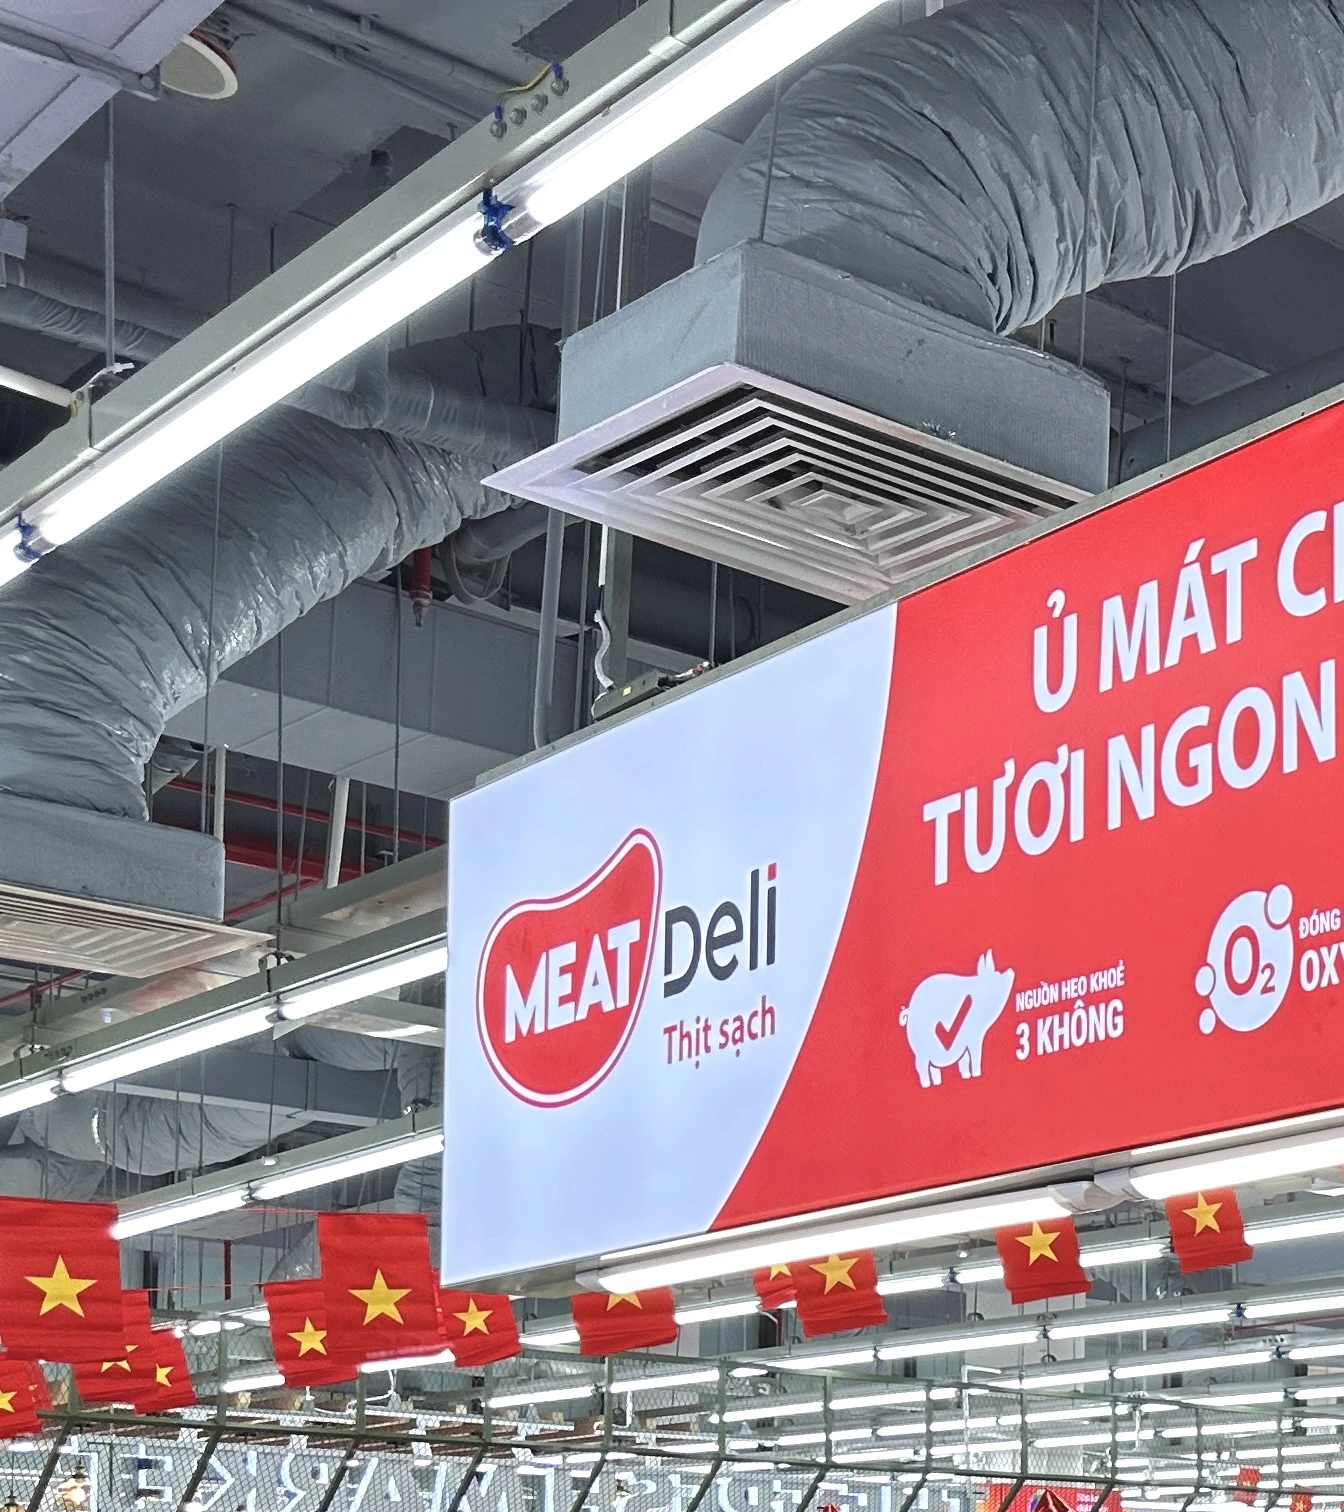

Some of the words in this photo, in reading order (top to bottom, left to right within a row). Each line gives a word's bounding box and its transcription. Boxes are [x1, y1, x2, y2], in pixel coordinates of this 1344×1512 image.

[1033, 589, 1078, 713] Ủ
[1099, 538, 1259, 693] MÁT
[922, 744, 1084, 886] TƯƠI
[1105, 660, 1336, 829] NGON
[663, 862, 778, 998] Deli
[1298, 906, 1339, 941] ĐÓNG
[503, 919, 642, 1044] MEAT
[1016, 980, 1059, 1014] NGUỒN
[1061, 975, 1087, 1002] HEO
[1016, 1023, 1031, 1061] 3
[1037, 998, 1125, 1057] KHÔNG
[663, 1022, 711, 1069] Thịt
[718, 995, 777, 1061] sạch
